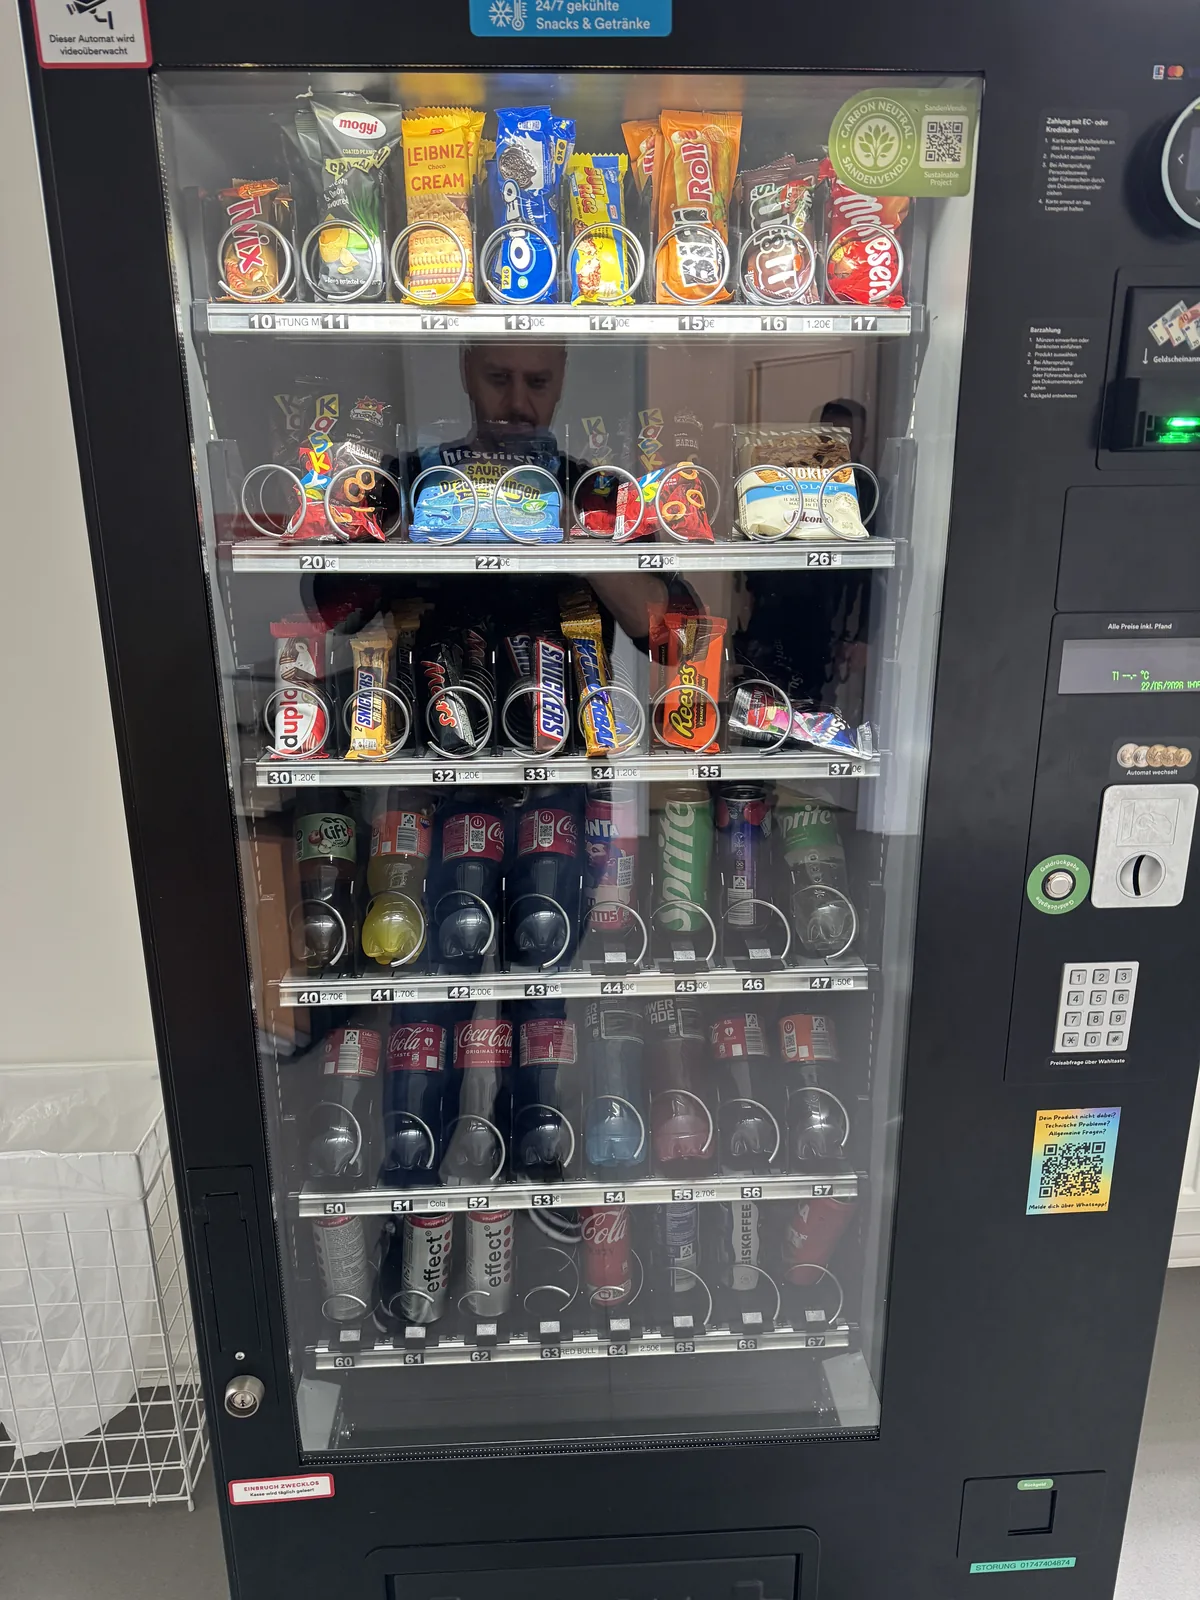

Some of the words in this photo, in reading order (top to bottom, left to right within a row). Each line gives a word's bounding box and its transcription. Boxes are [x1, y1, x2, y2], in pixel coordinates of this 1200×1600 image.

[535, 0, 563, 12] 24/7
[567, 0, 619, 14] gekühlte
[536, 17, 579, 30] Snacks
[583, 17, 591, 30] &
[594, 17, 650, 30] Getränke
[49, 34, 76, 43] Dieser
[78, 34, 115, 43] Automat
[116, 34, 135, 43] wird
[60, 46, 128, 55] videoüberwacht
[924, 103, 967, 112] SandenVendo
[840, 100, 876, 139] CARBON
[878, 100, 914, 140] NEUTRAL
[1046, 117, 1071, 126] Zahlung
[339, 118, 378, 135] mogyi
[407, 143, 465, 167] LEIBNIZ
[427, 163, 447, 171] Choco
[842, 156, 909, 185] SANDENVENDO
[682, 143, 713, 203] Roll
[924, 171, 960, 179] Sustainable
[411, 172, 465, 192] CREAM
[930, 179, 953, 187] Project
[250, 315, 275, 329] 10
[323, 315, 345, 329] 11
[422, 316, 447, 330] 12
[506, 316, 532, 330] 13
[590, 316, 615, 330] 14
[681, 316, 705, 330] 15
[763, 317, 785, 330] 16
[806, 319, 831, 329] 1.20€
[854, 317, 876, 330] 17
[1030, 326, 1062, 335] Barzahlung
[301, 556, 324, 569] 20
[477, 556, 499, 569] 22
[640, 555, 662, 568] 24
[808, 554, 830, 566] 26
[1107, 623, 1120, 631] Alle
[1120, 623, 1140, 631] Preise
[539, 642, 565, 740] SNICKERS
[526, 769, 546, 780] 33
[593, 768, 614, 779] 34
[617, 768, 638, 777] 1.20€
[700, 766, 719, 778] 35
[830, 763, 850, 775] 37
[1152, 768, 1178, 776] wechselt
[269, 771, 290, 784] 30
[293, 773, 316, 783] 1.20€
[433, 770, 454, 782] 32
[458, 771, 479, 780] 1.20€
[1040, 859, 1080, 873] Geldrückgabe
[1098, 973, 1105, 982] 2
[1121, 972, 1127, 981] 3
[602, 983, 622, 993] 44
[676, 981, 696, 992] 45
[744, 979, 763, 990] 46
[811, 978, 830, 989] 47
[831, 978, 852, 986] 1.50€
[372, 990, 393, 1001] 41
[394, 989, 415, 998] 1.70€
[449, 988, 470, 999] 42
[471, 988, 492, 997] 2.00€
[526, 985, 547, 996] 43
[299, 992, 319, 1004] 40
[321, 992, 343, 1001] 2.70€
[1072, 995, 1079, 1003] 4
[1095, 994, 1102, 1003] 5
[1118, 993, 1125, 1002] 6
[1071, 1015, 1077, 1024] 7
[1093, 1015, 1099, 1024] 8
[1115, 1014, 1121, 1023] 9
[1090, 1036, 1097, 1044] 0
[673, 1189, 692, 1200] 55
[695, 1189, 715, 1198] 2.70€
[742, 1187, 761, 1198] 56
[813, 1184, 832, 1196] 57
[468, 1197, 488, 1208] 52
[533, 1195, 552, 1206] 53
[605, 1192, 624, 1203] 54
[325, 1203, 344, 1214] 50
[392, 1201, 411, 1212] 51
[424, 1233, 443, 1293] effect
[484, 1228, 501, 1288] effect
[676, 1342, 694, 1352] 65
[738, 1339, 756, 1349] 66
[807, 1337, 825, 1347] 67
[542, 1348, 560, 1359] 63
[577, 1347, 596, 1355] BULL
[608, 1345, 627, 1355] 64
[335, 1357, 353, 1367] 60
[405, 1354, 423, 1364] 61
[471, 1352, 489, 1361] 62
[243, 1484, 279, 1492] EINBRUCH
[280, 1480, 320, 1489] ZWECKLOS
[278, 1488, 296, 1496] täglich
